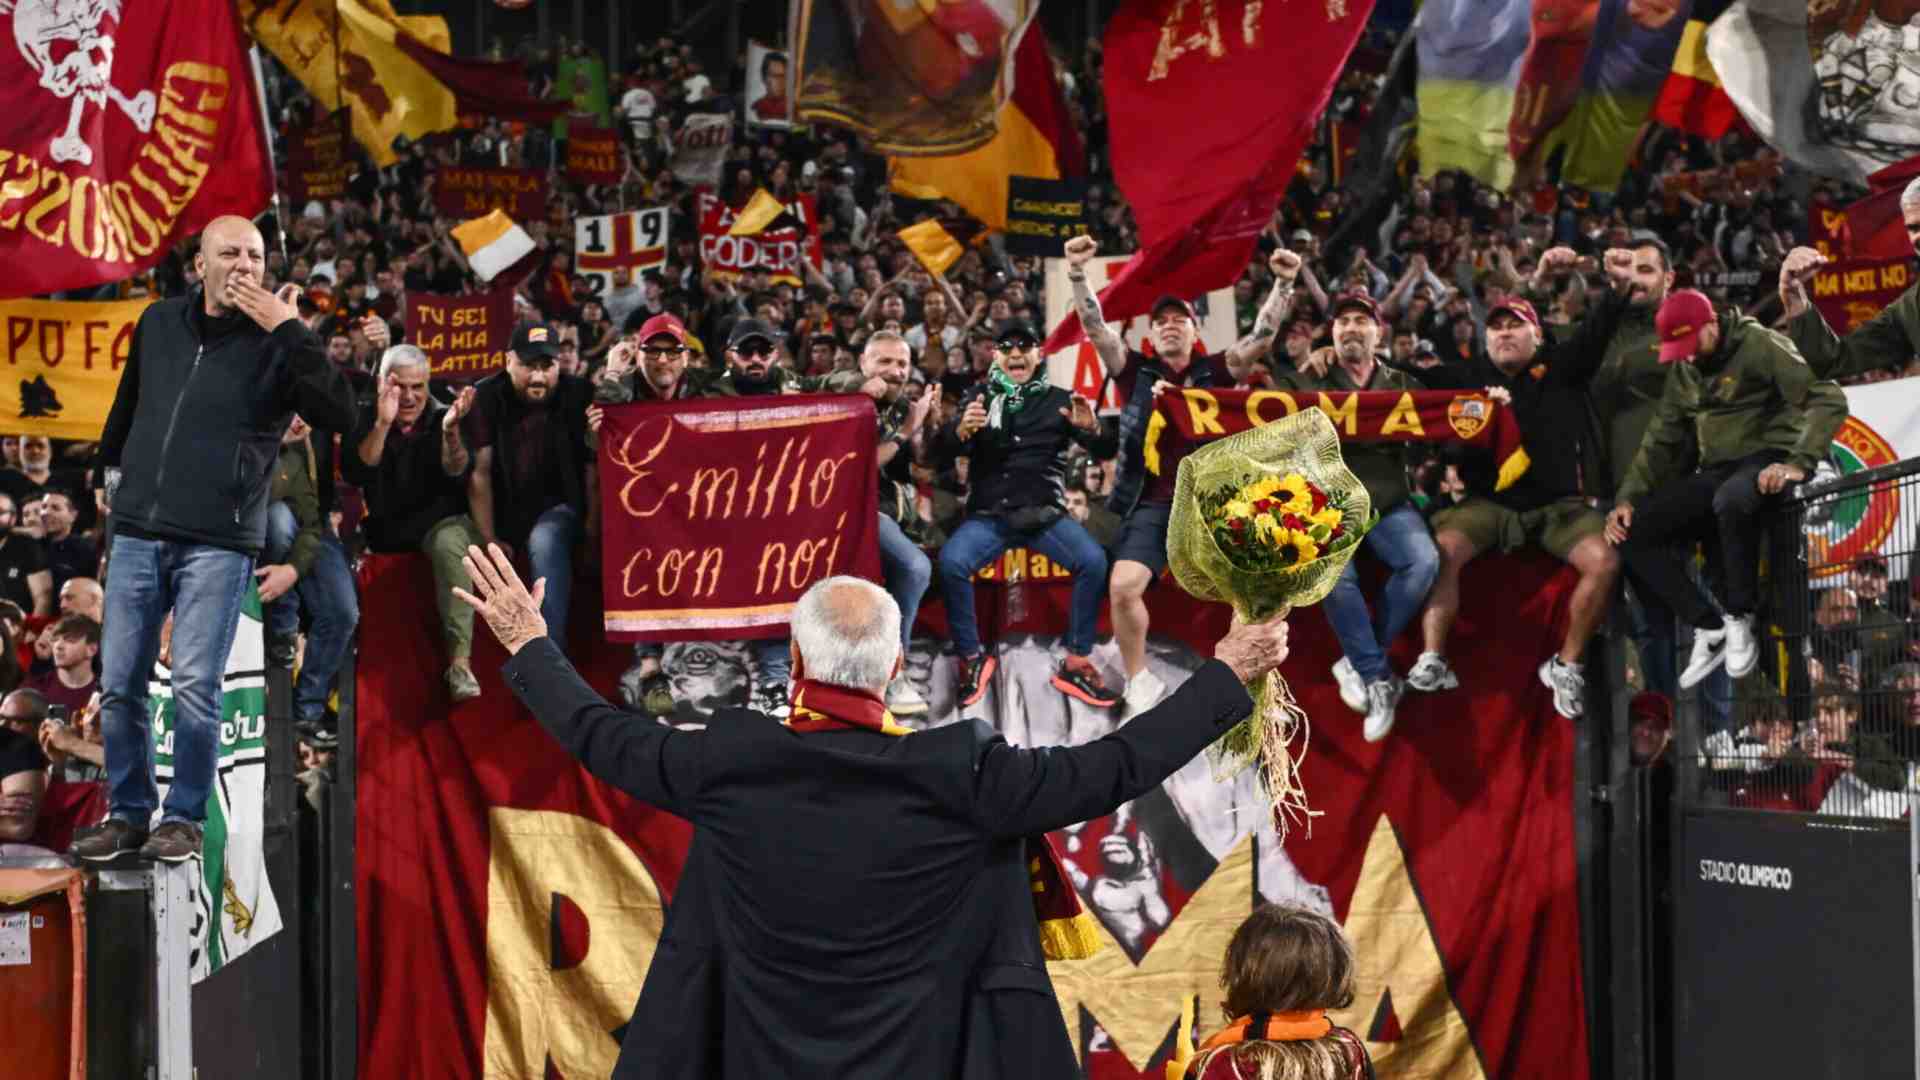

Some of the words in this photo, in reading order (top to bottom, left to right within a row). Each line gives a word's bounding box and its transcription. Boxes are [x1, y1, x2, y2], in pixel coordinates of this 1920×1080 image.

[416, 304, 445, 326] TU
[450, 305, 487, 327] SEI
[7, 315, 72, 368] PO'
[416, 330, 445, 350] LA
[1182, 389, 1425, 437] ROMA
[606, 415, 857, 519] Emilio
[621, 547, 723, 597] con
[754, 510, 847, 596] noi
[1699, 859, 1736, 884] STADIO
[1737, 862, 1792, 891] OLIMPICO
